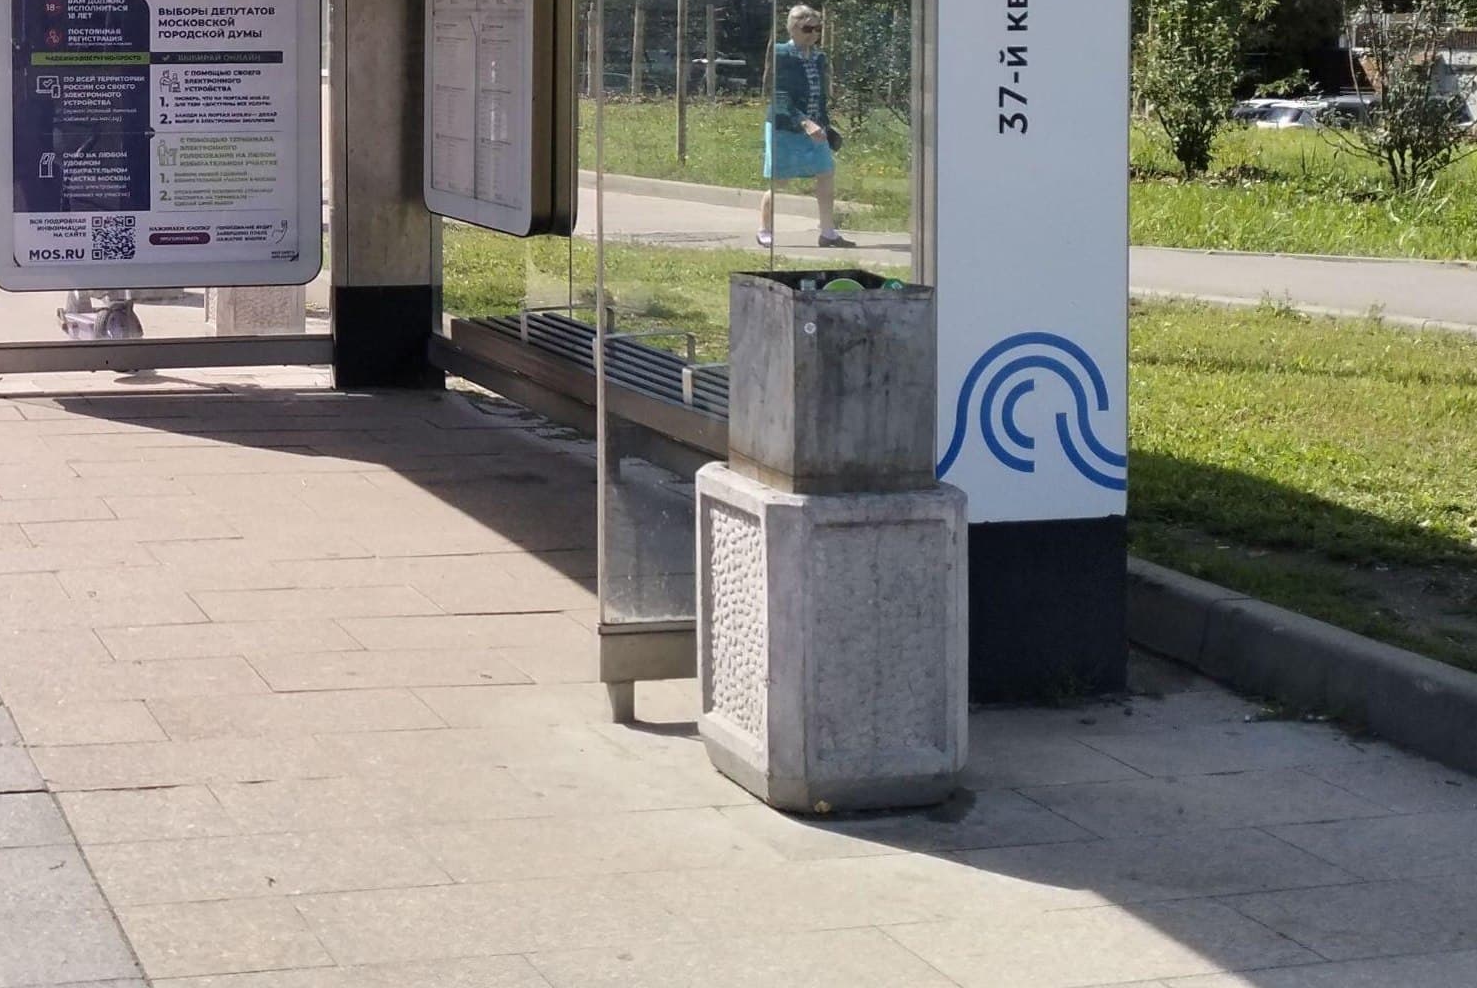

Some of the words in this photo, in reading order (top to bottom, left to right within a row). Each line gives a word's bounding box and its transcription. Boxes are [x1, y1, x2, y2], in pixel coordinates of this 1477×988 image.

[77, 12, 93, 20] ЛЕТ
[158, 7, 209, 16] ВЫБОРЫ
[211, 7, 276, 16] ДЕПУТАТОВ
[158, 17, 236, 27] МОСКОВСКОЙ
[158, 28, 225, 39] ГОРОДСКОЙ
[227, 29, 262, 39] ДУМЫ
[999, 46, 1028, 134] 37-й
[29, 248, 85, 261] MOS.RU
